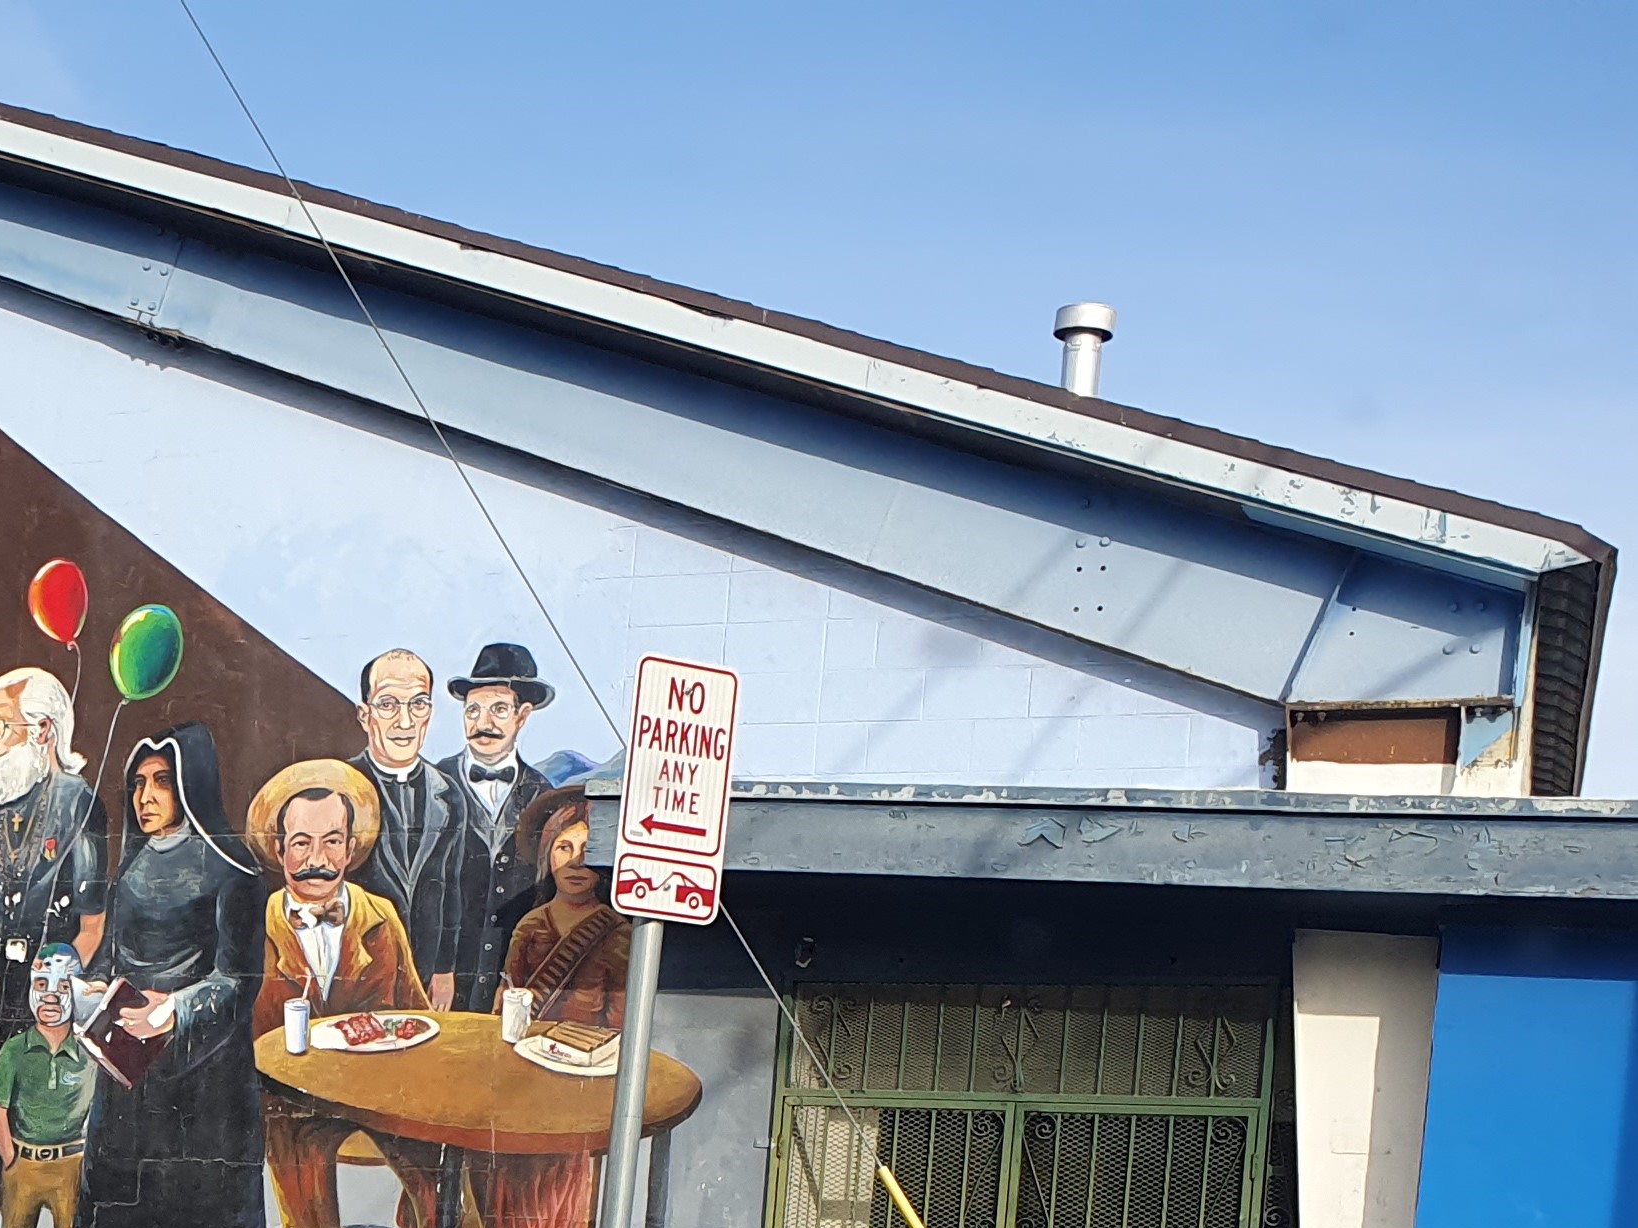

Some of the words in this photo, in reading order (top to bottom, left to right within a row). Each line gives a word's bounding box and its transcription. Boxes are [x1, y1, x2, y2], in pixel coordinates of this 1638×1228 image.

[667, 676, 706, 715] NO
[637, 714, 726, 762] PARKING
[658, 758, 699, 786] ANY
[652, 786, 700, 815] TIME
